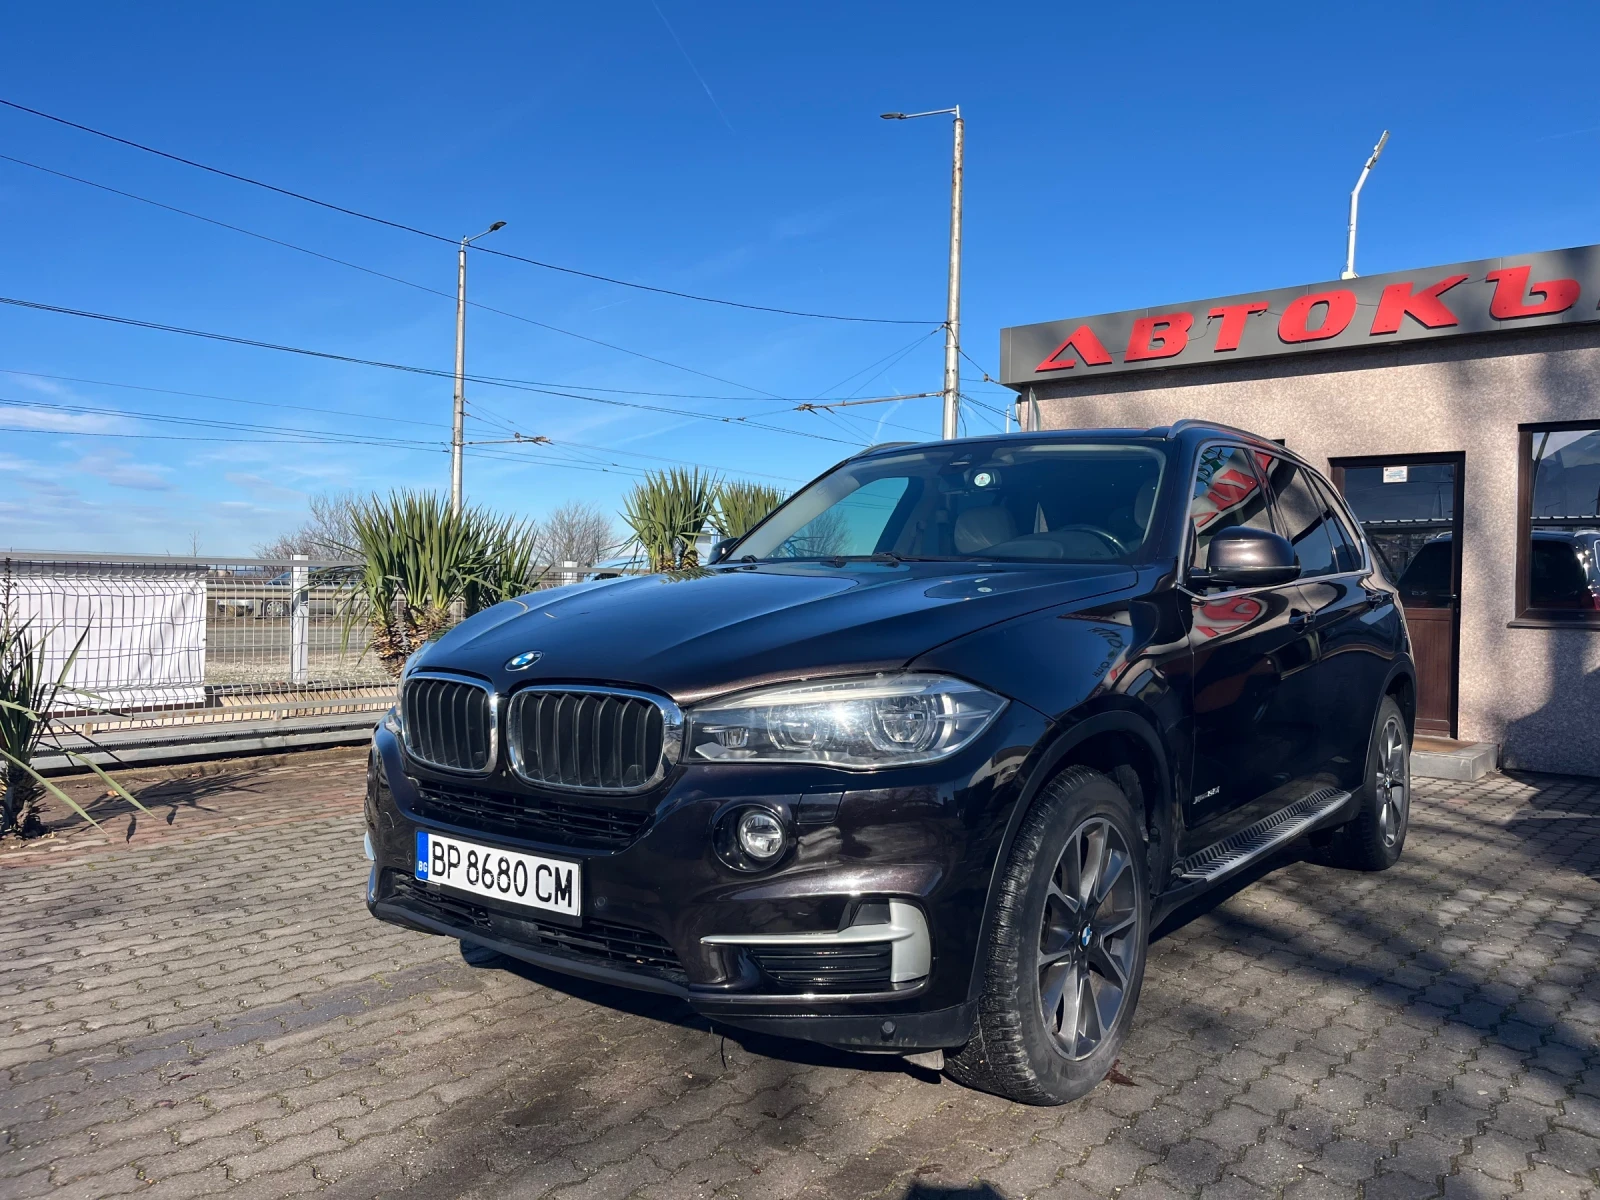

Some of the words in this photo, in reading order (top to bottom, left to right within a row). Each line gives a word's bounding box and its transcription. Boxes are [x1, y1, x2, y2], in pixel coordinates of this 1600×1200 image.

[1034, 265, 1600, 373] АВТОКЪ
[418, 860, 428, 872] BG
[432, 841, 461, 879] BP
[466, 849, 528, 897] 8680
[535, 863, 573, 908] CM
